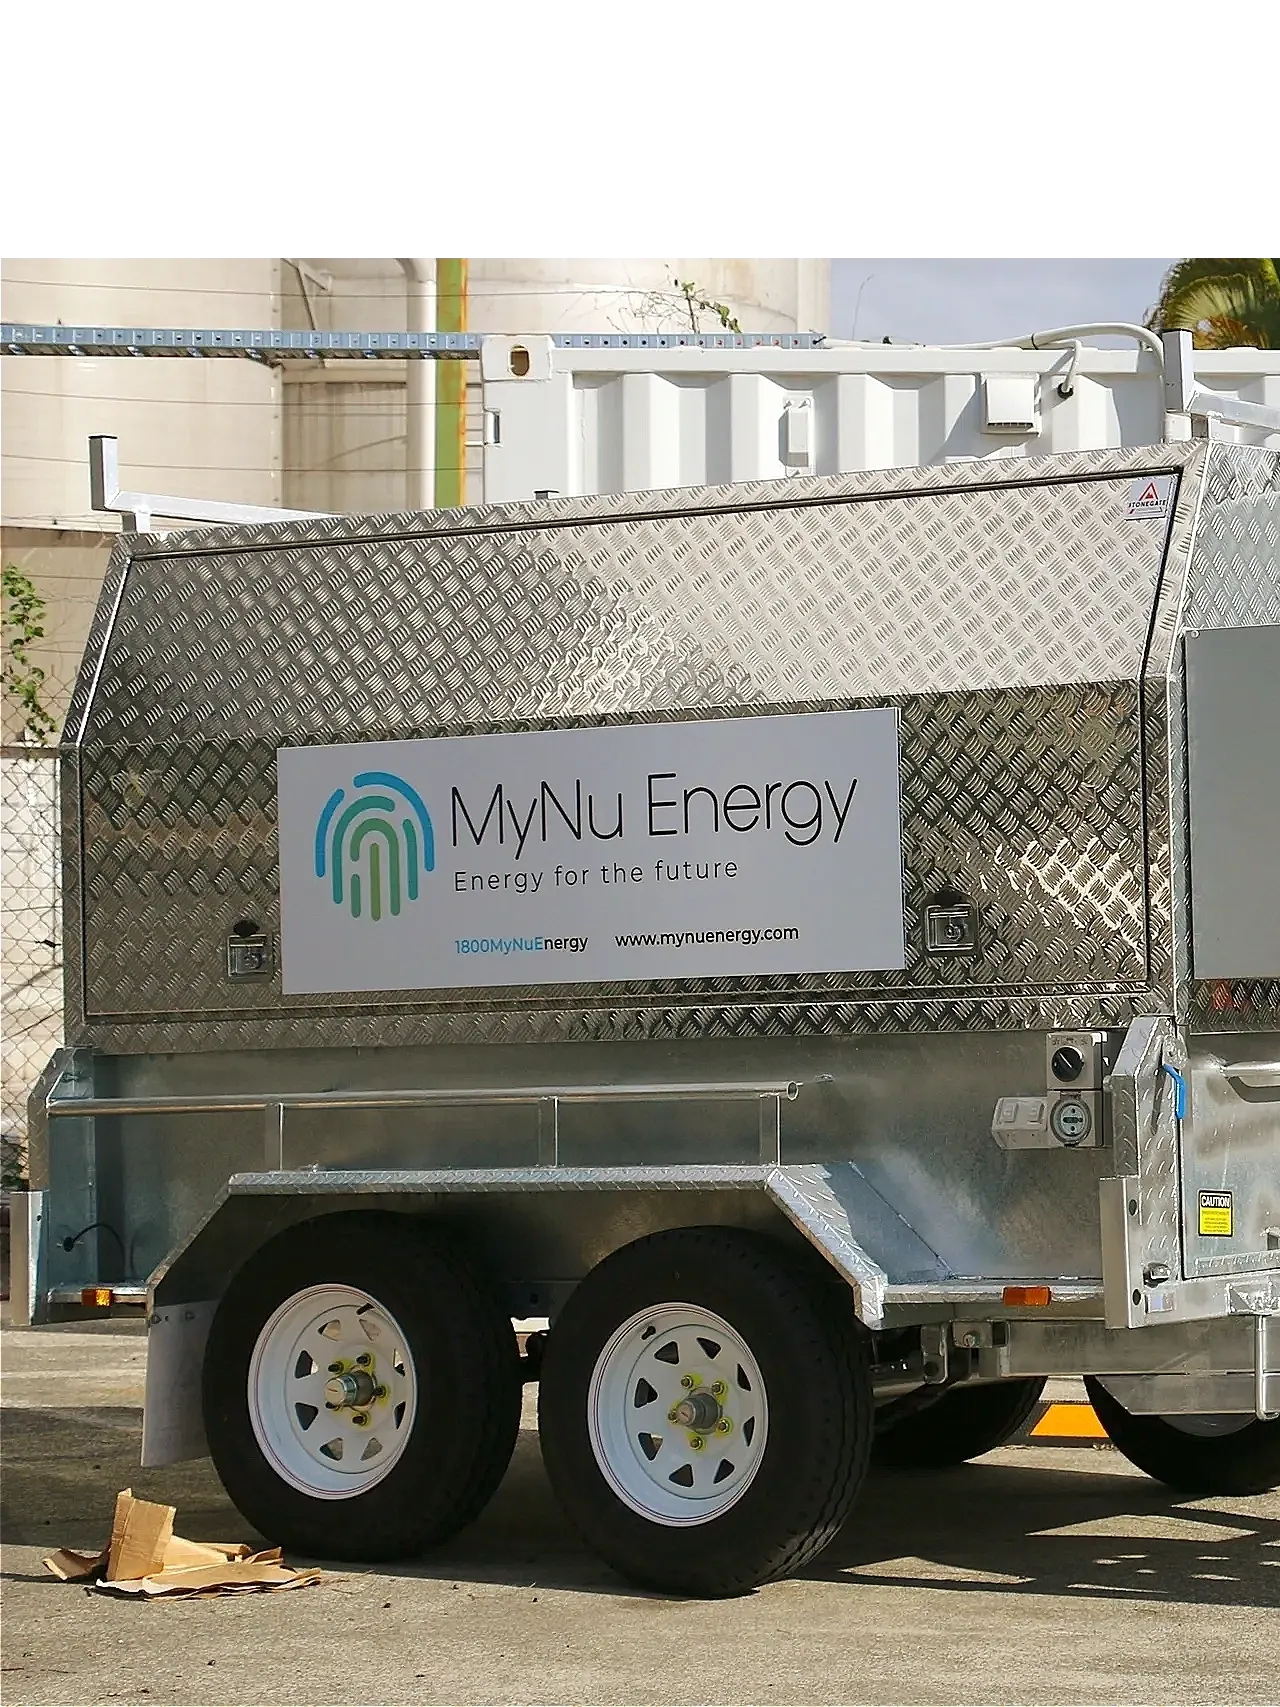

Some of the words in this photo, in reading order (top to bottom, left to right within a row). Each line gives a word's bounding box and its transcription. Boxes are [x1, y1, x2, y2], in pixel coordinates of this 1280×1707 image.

[451, 778, 624, 861] MyNu
[647, 772, 858, 847] Energy
[453, 870, 544, 894] Energy
[554, 864, 590, 887] for
[600, 861, 643, 884] the
[654, 858, 738, 881] future
[453, 934, 589, 956] 1800MyNuEnergy
[614, 926, 800, 949] www.mynuenergy.com
[1202, 1196, 1230, 1207] CAUTION
